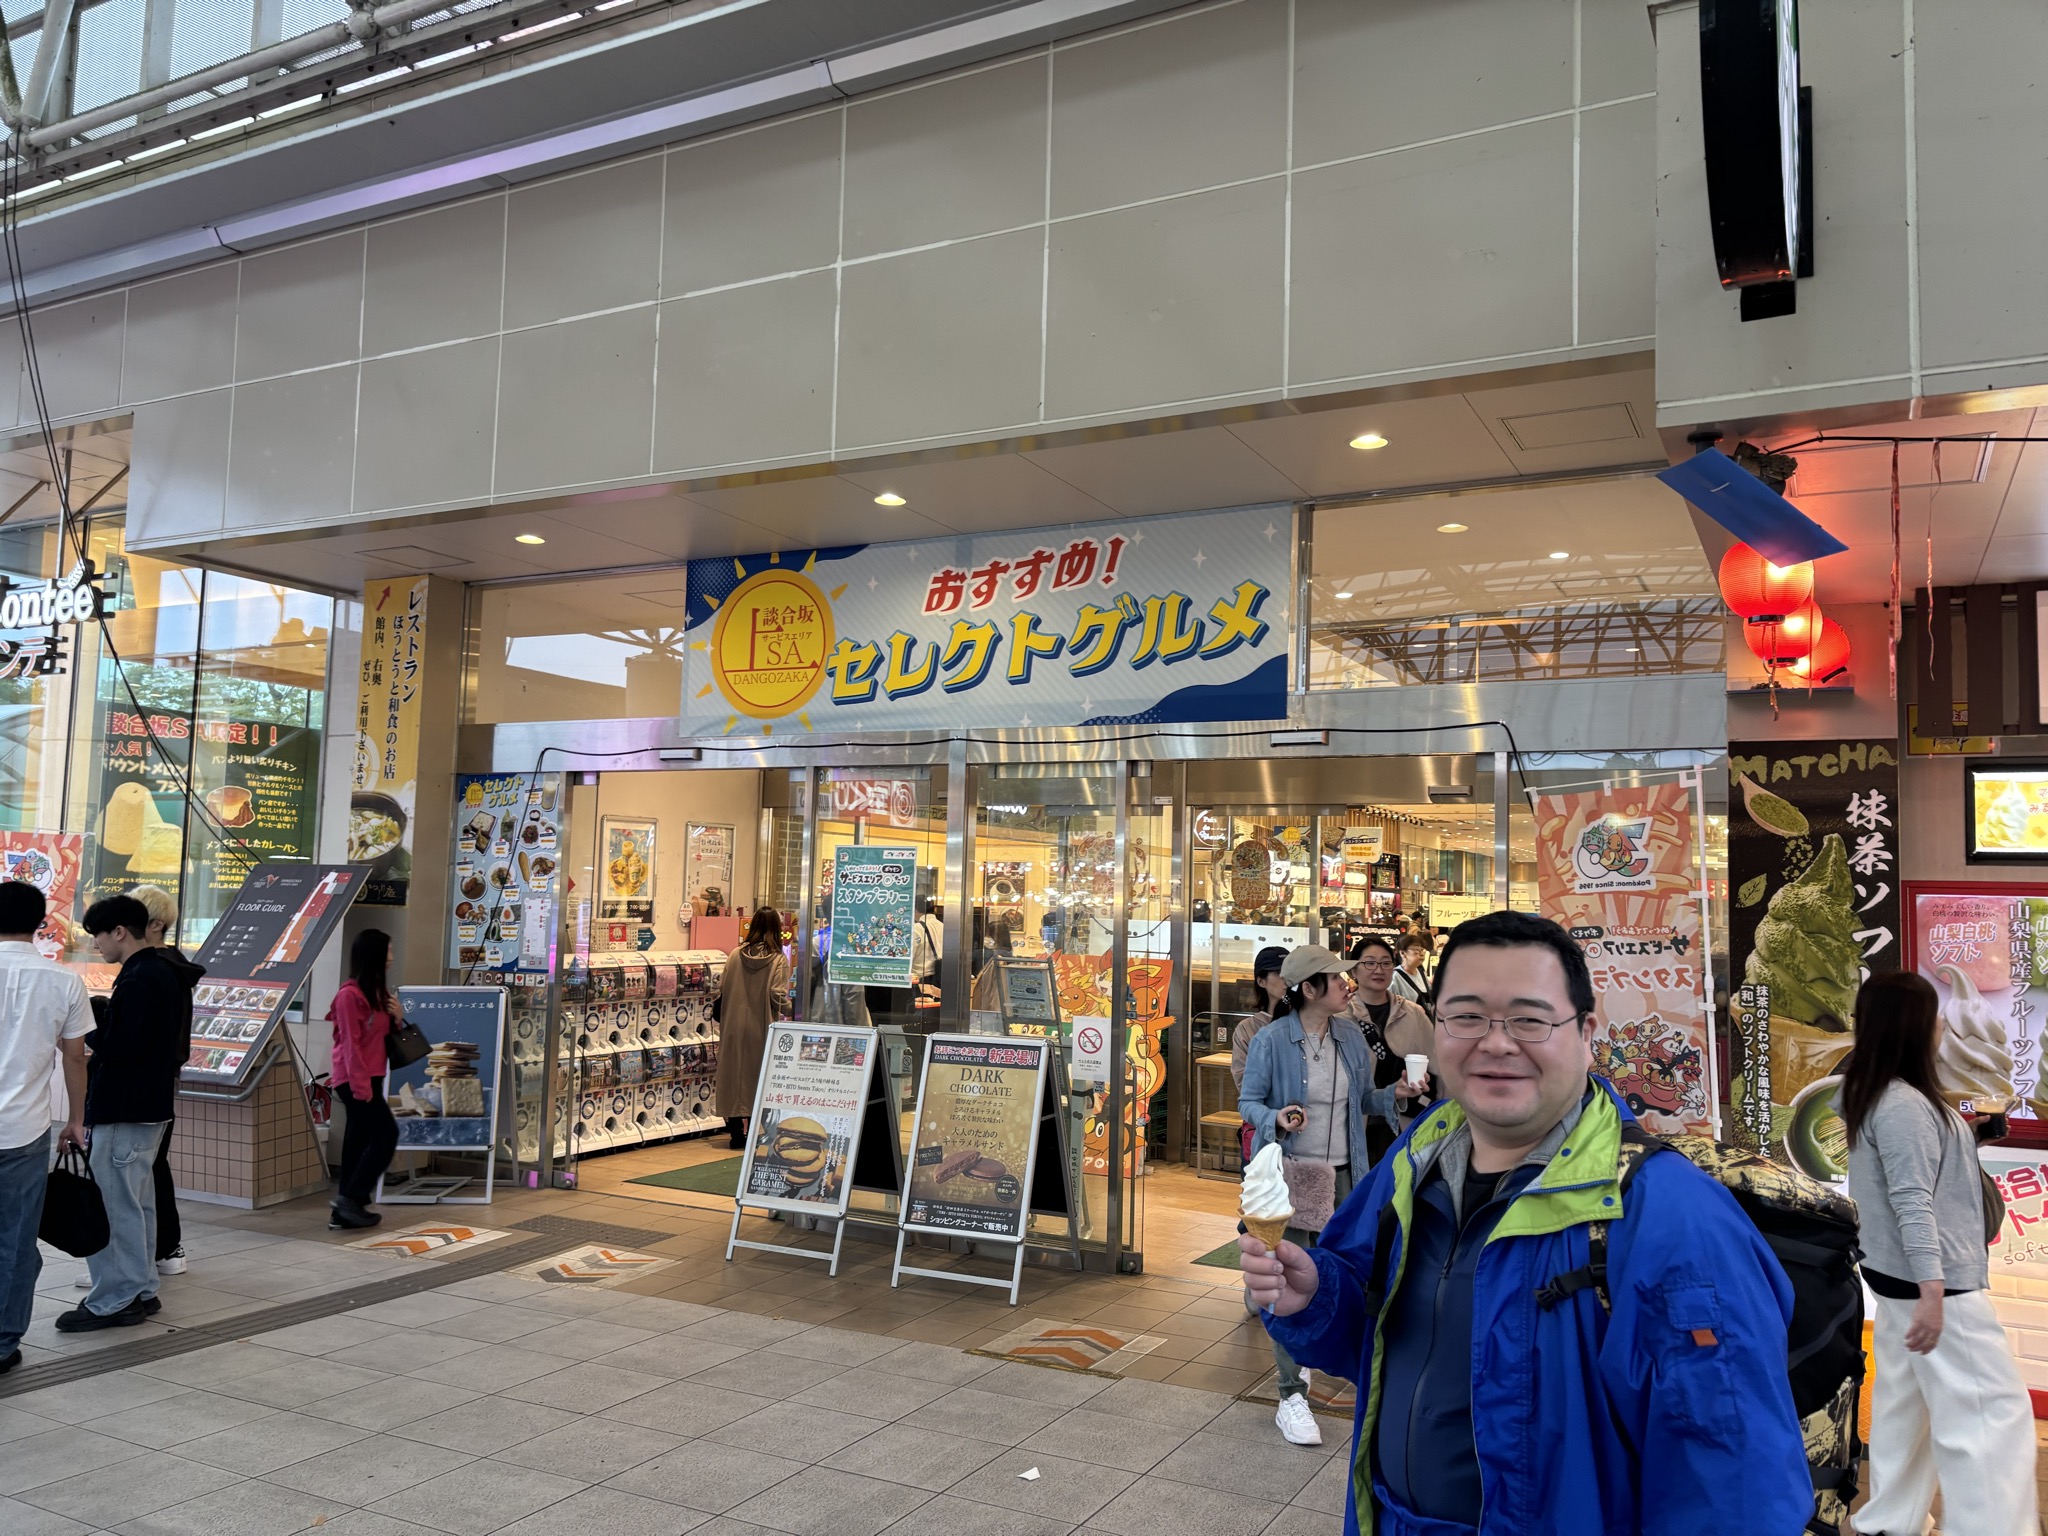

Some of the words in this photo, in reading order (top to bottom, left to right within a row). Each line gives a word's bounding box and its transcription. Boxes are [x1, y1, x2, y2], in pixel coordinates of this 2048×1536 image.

[923, 532, 1130, 616] おすすめ！
[0, 578, 95, 629] ontee
[762, 604, 815, 627] 談合坂
[374, 616, 385, 649] 館内、
[761, 631, 813, 642] サービスエリア
[826, 578, 1271, 706] セレクトグルメ
[402, 591, 423, 704] レストラン
[766, 639, 805, 666] SA
[371, 658, 383, 686] 右奥
[732, 671, 810, 686] DANGOZAKA
[383, 615, 404, 780] ほうとうと和食のお店
[355, 693, 370, 790] ご利用下さいませ。
[1730, 742, 1898, 787] MATCHA
[838, 887, 910, 905] スタンプラリー
[1846, 788, 1894, 988] 抹茶ソフ
[236, 903, 261, 912] FLOOR
[262, 904, 287, 913] GUIDE
[1929, 920, 1997, 945] 山梨白桃
[1929, 943, 1983, 964] ソフト
[419, 1002, 495, 1010] 東京ミルクチーズ工場
[2008, 901, 2036, 1118] 山梨県産フルーツソフト
[960, 1067, 1005, 1084] DARK
[1755, 985, 1771, 1158] 抹茶のさわやかな風味を活かした
[950, 1083, 1012, 1097] CHOCOLATE
[943, 1136, 1005, 1150] キャラメルサンド
[952, 1126, 998, 1138] 大人のための
[752, 1179, 787, 1189] CARAMEL
[754, 1171, 769, 1179] THE
[770, 1172, 787, 1181] BEST
[930, 1215, 1014, 1233] ショッピングコーナーで販売中！
